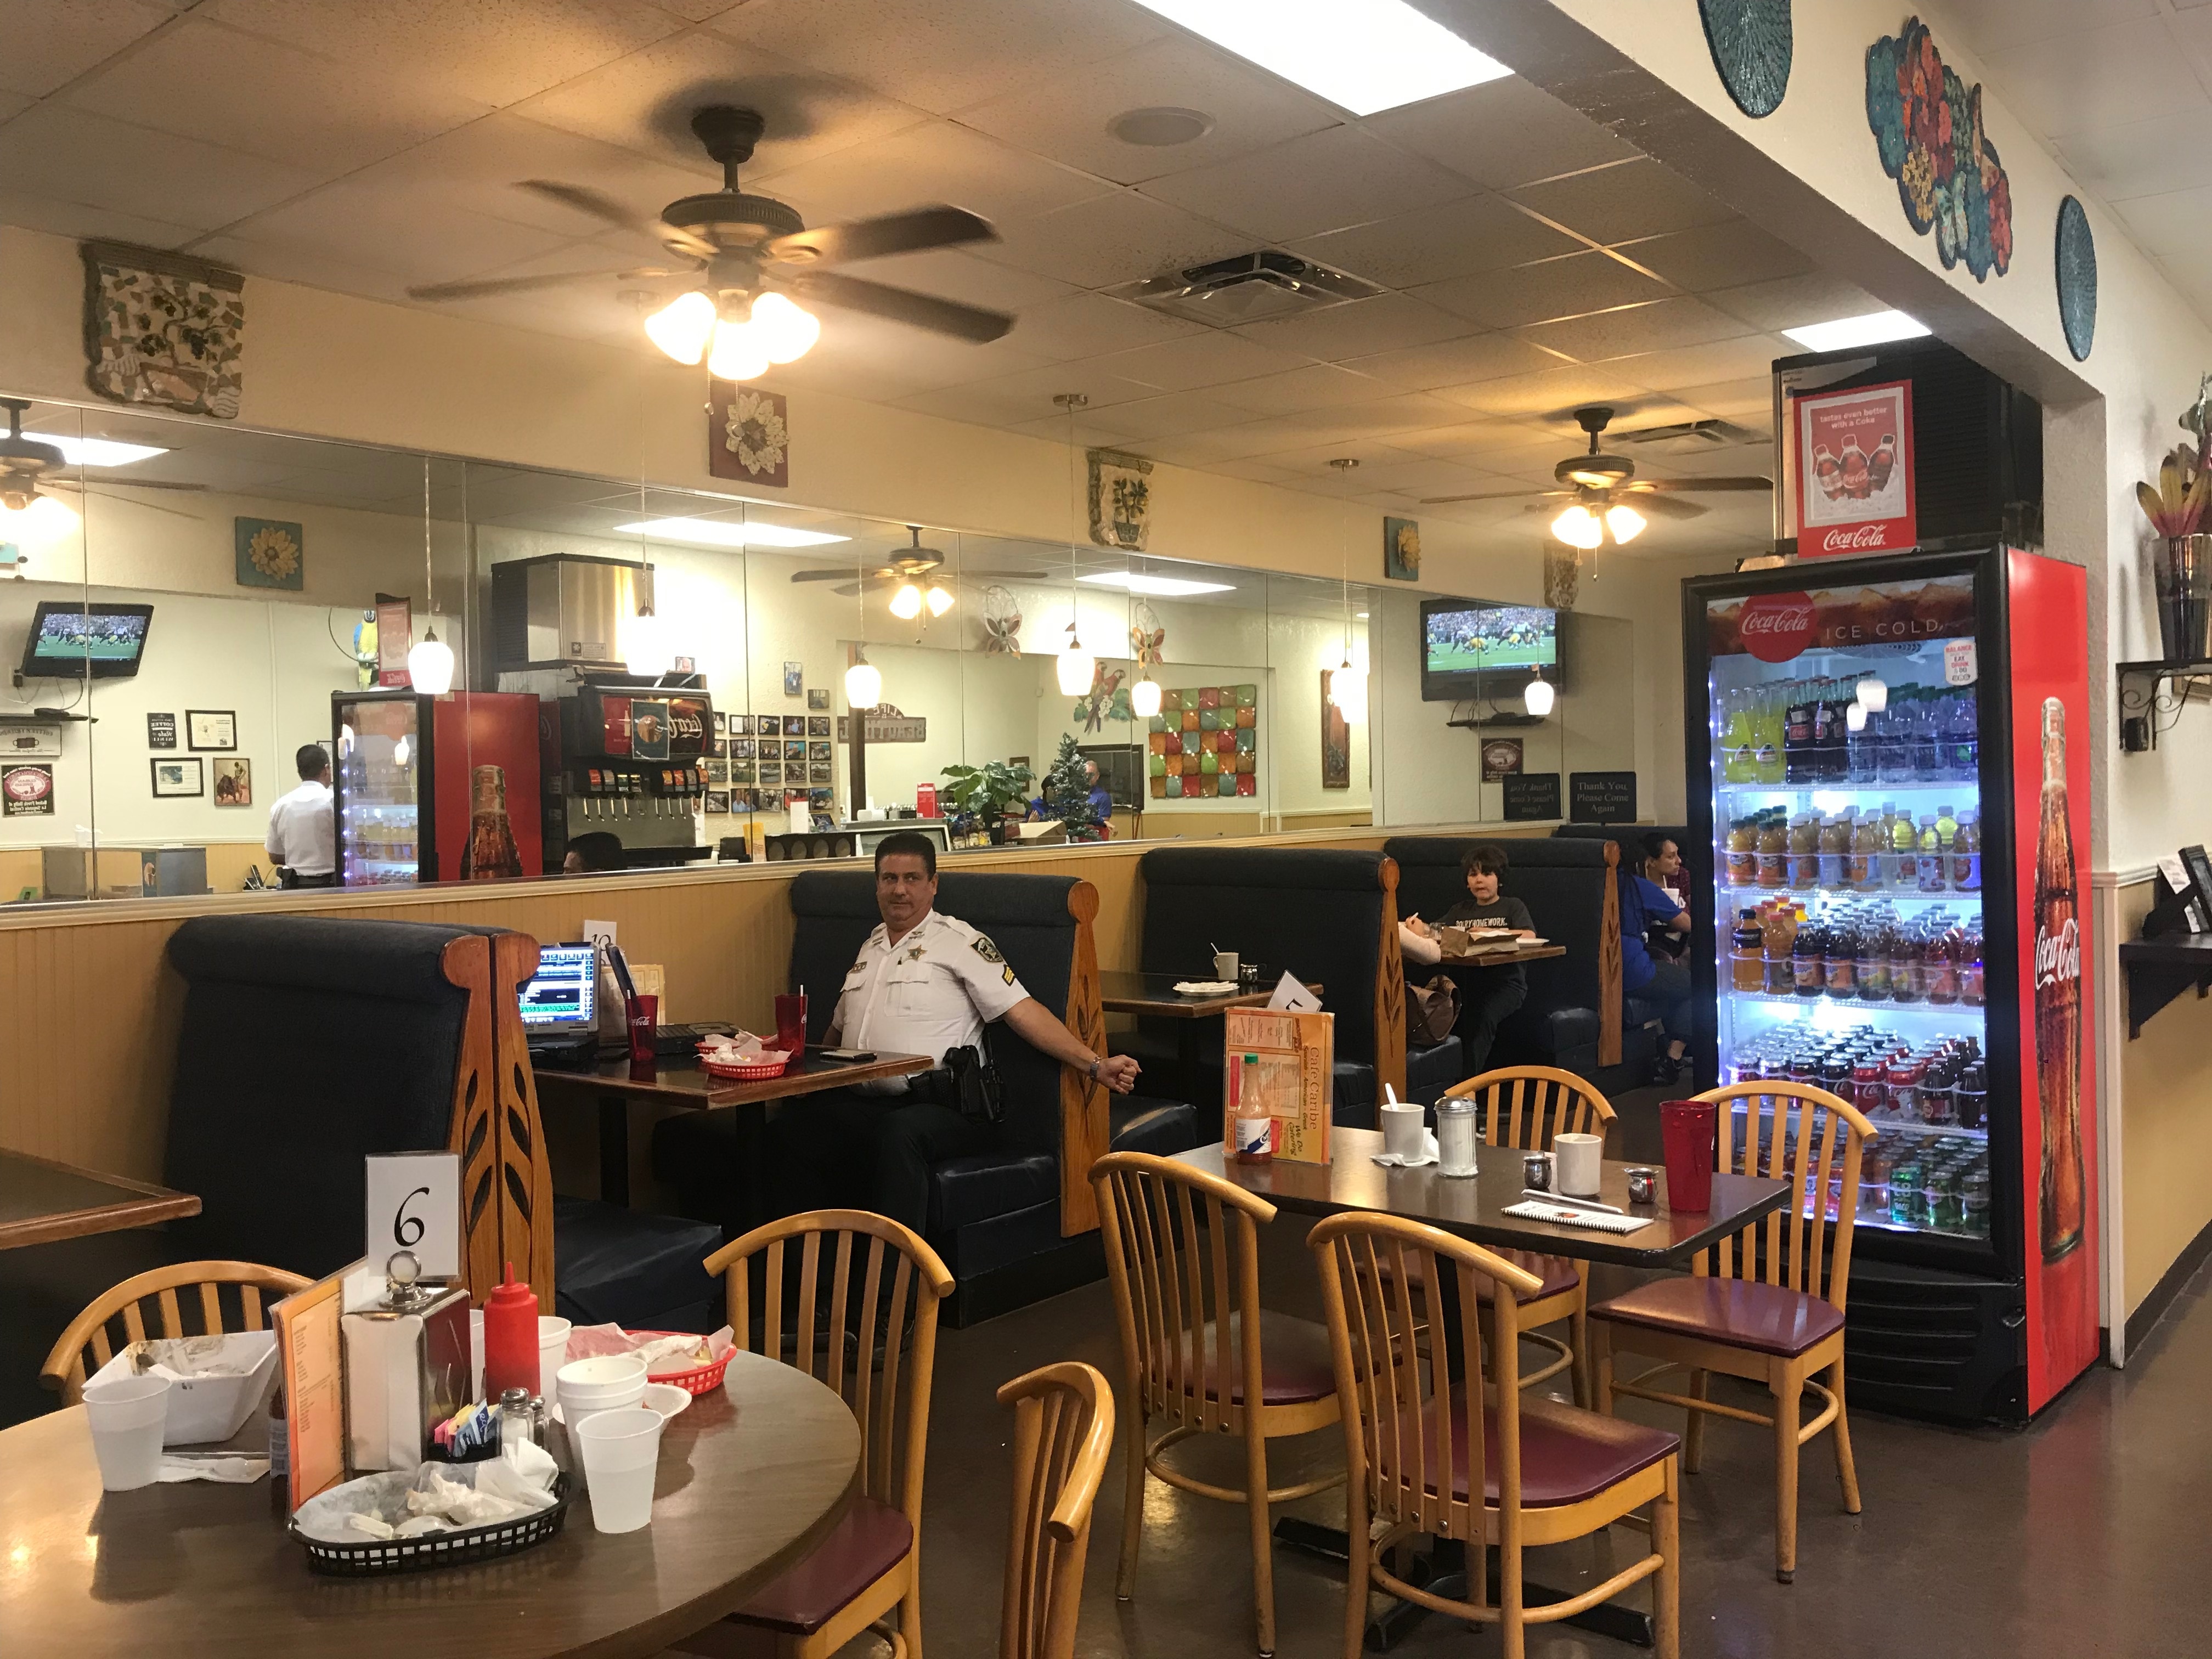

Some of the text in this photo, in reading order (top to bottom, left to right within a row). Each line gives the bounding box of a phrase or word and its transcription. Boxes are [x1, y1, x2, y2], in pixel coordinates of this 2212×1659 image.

[1820, 407, 1887, 422] tastes even better
[1831, 420, 1847, 428] with
[1855, 416, 1875, 426] Coke
[1823, 524, 1887, 551] Coca-Cola
[1741, 607, 1810, 635] Coca-Cola
[1826, 619, 1939, 640] ICE COLD
[1945, 645, 1972, 653] BALANCE
[1577, 782, 1606, 791] Thank
[1577, 793, 1628, 802] Please Come
[1591, 804, 1615, 814] Again
[2035, 918, 2079, 990] Coca-Cola
[1310, 1047, 1319, 1130] Cafe Caribe
[1295, 1125, 1303, 1152] We Do
[394, 1187, 430, 1247] 6
